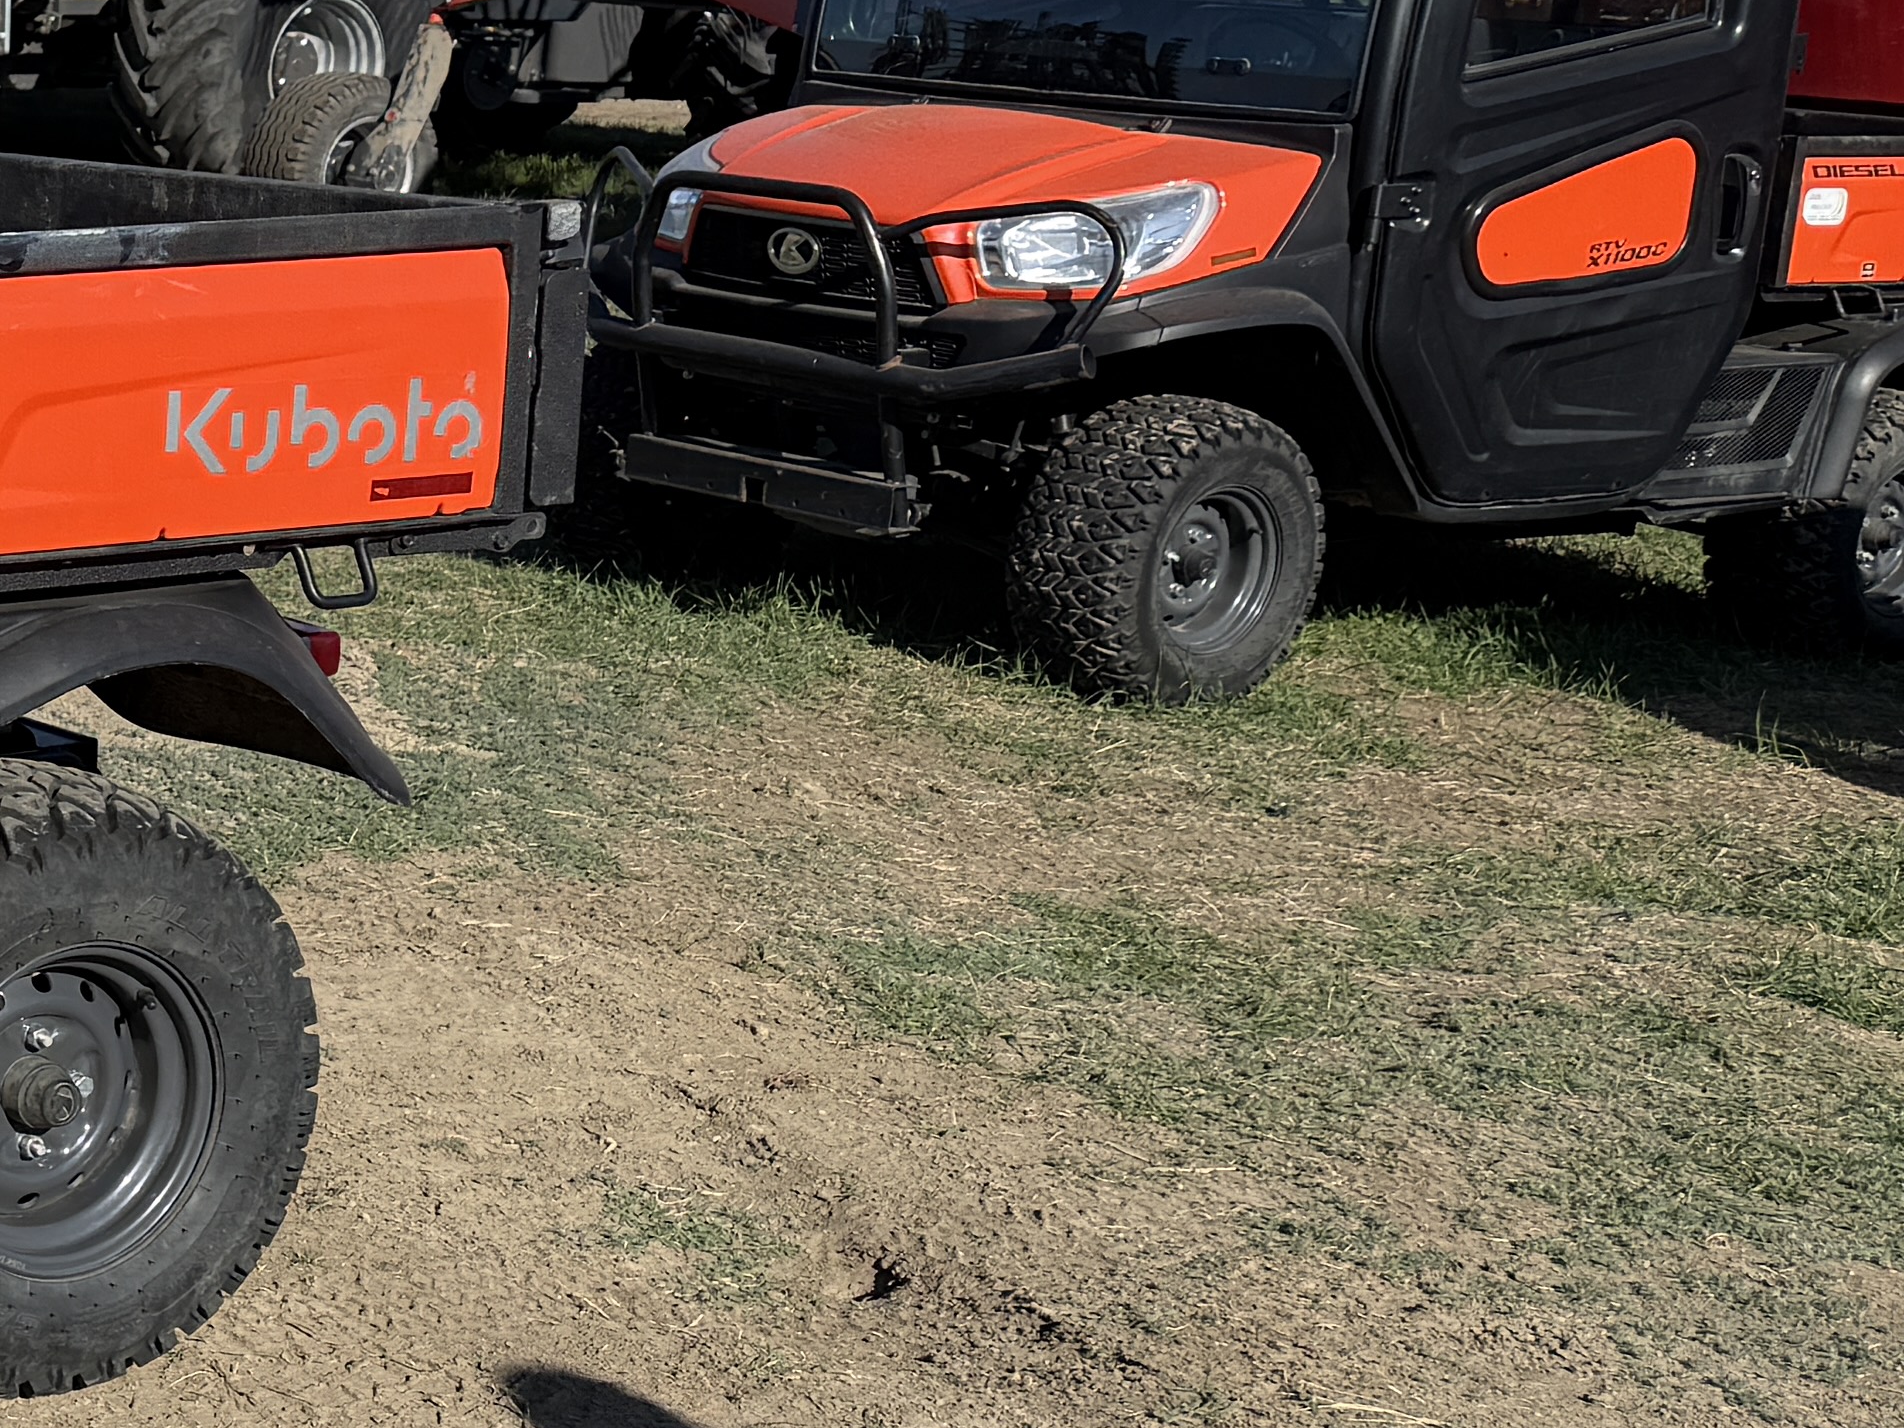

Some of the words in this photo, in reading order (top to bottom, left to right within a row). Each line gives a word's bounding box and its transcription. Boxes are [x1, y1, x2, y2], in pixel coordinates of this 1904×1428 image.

[1812, 164, 1904, 179] DIESEL
[1586, 242, 1667, 267] X1100C
[1589, 238, 1627, 253] RTV
[165, 378, 484, 474] Kubota
